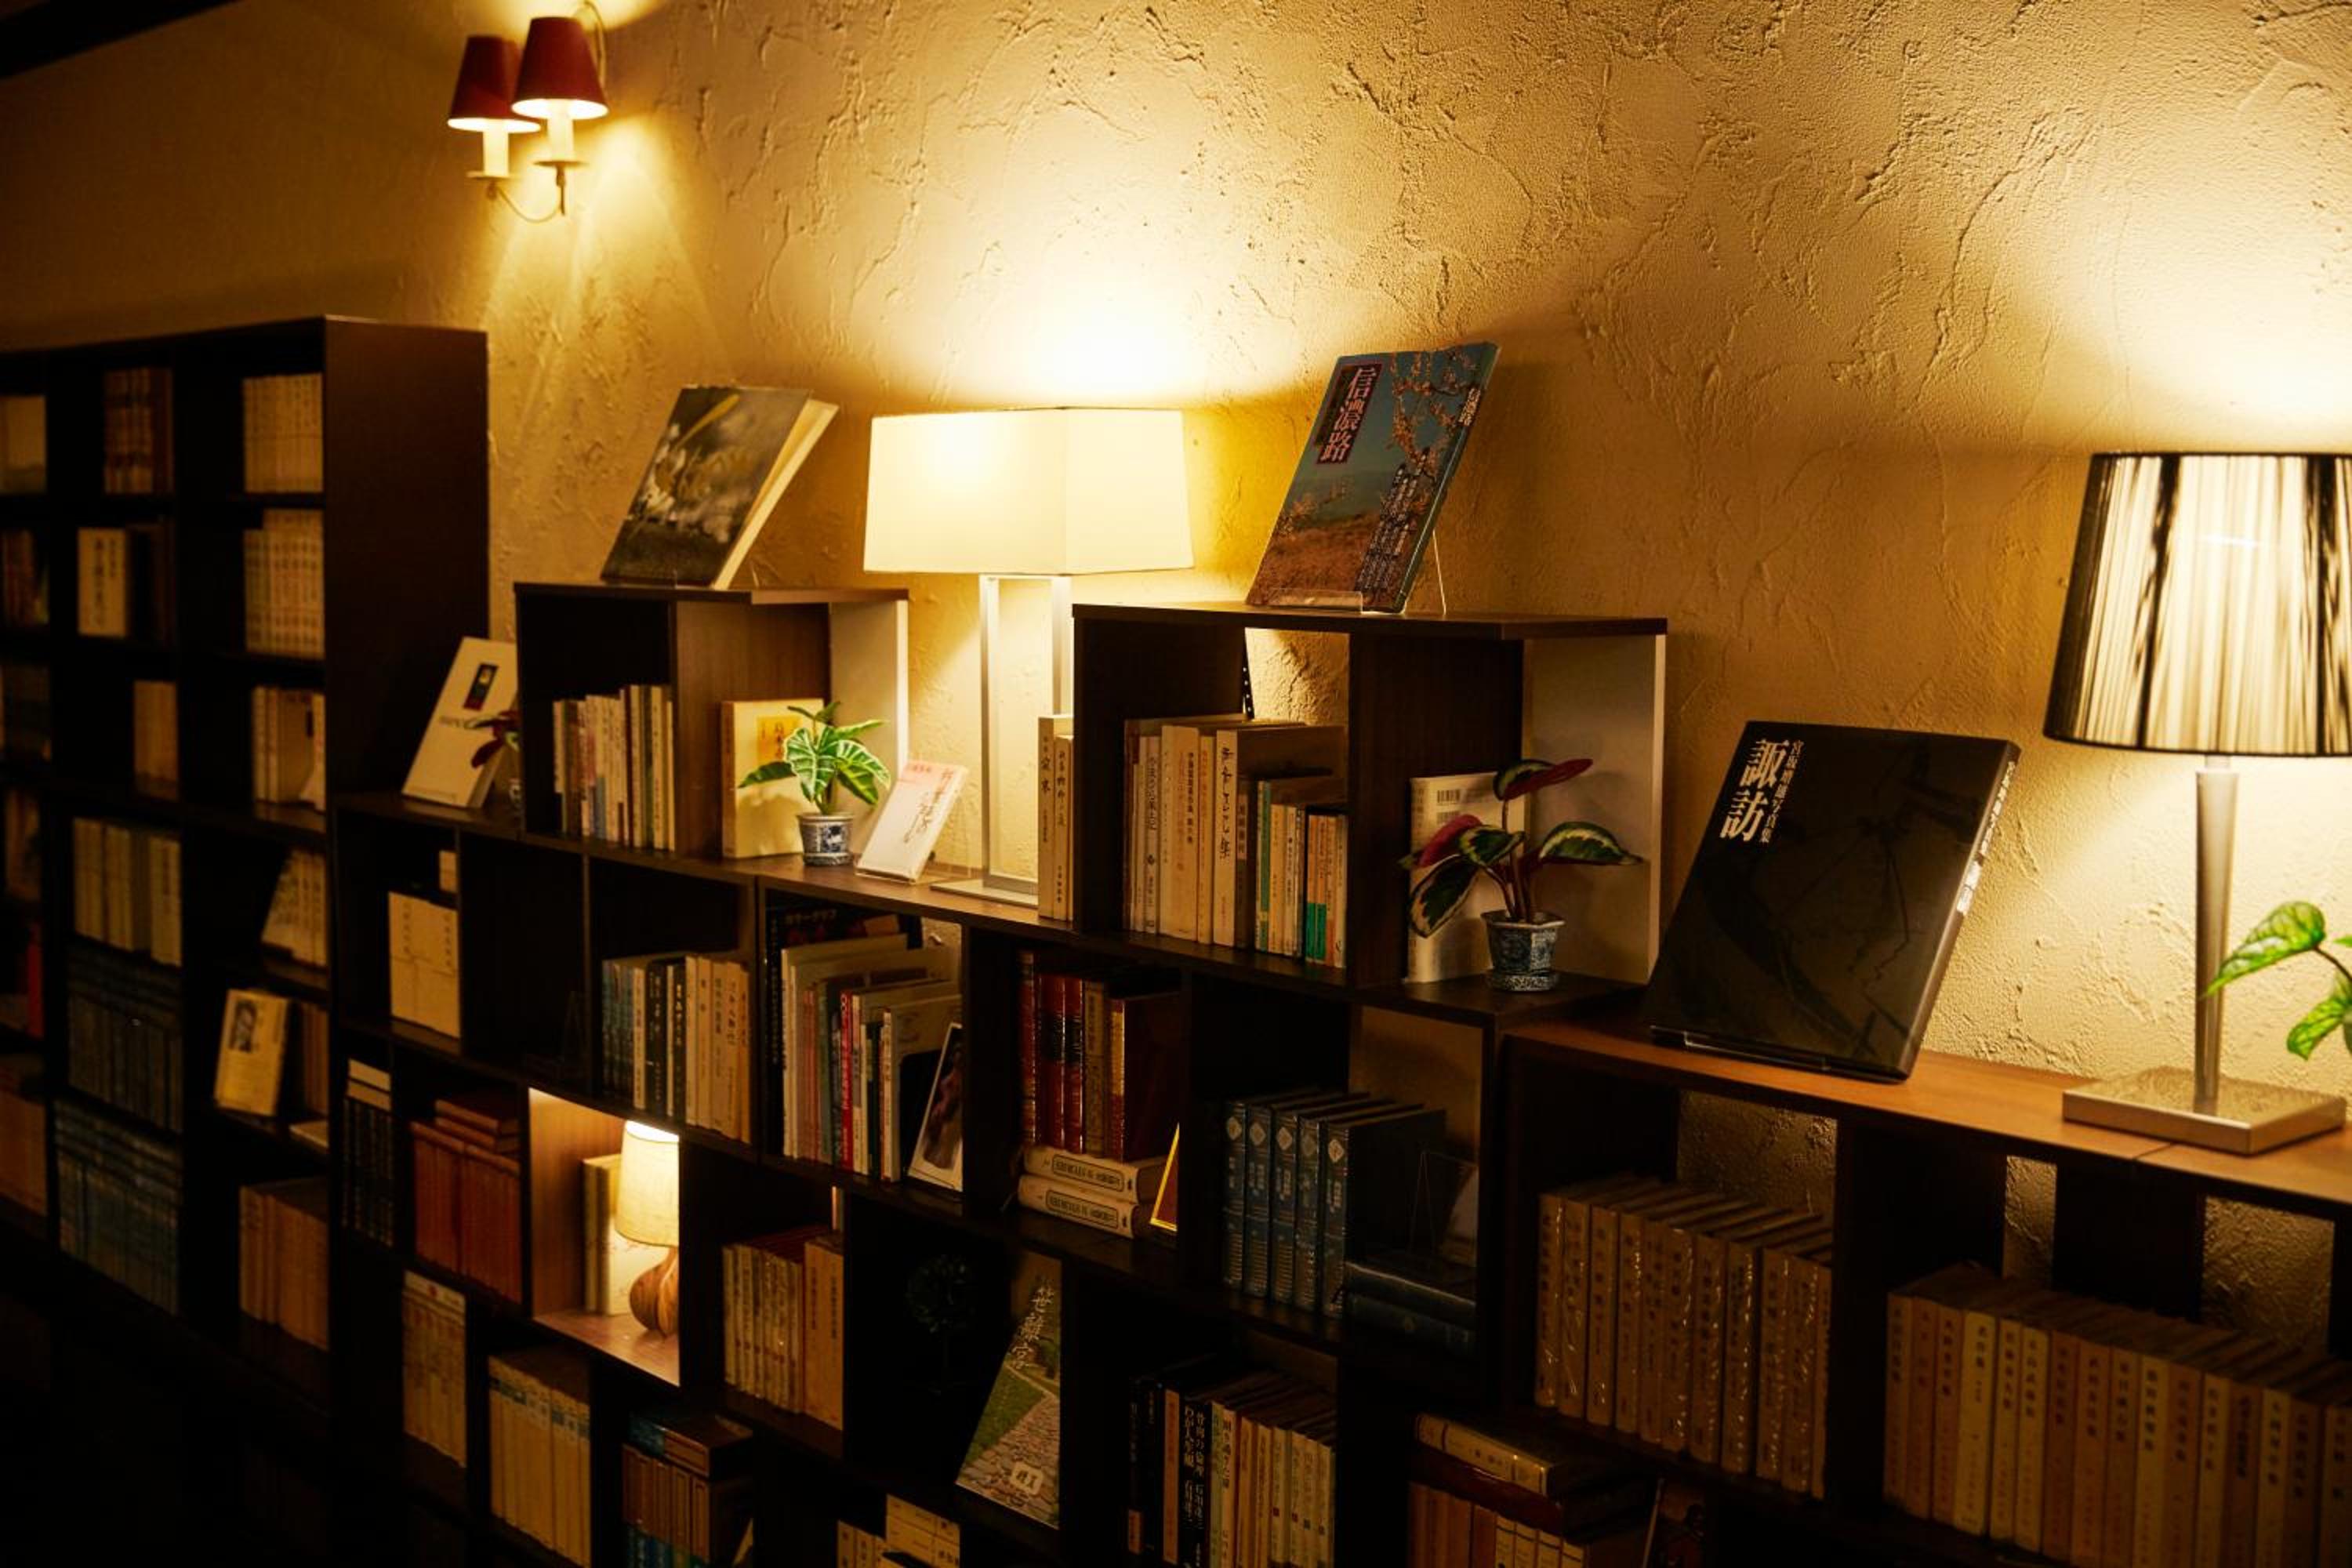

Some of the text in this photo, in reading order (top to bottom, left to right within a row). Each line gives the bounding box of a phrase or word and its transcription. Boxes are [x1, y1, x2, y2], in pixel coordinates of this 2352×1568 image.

[1319, 365, 1377, 463] 信濃路
[1719, 739, 1790, 842] 諏訪
